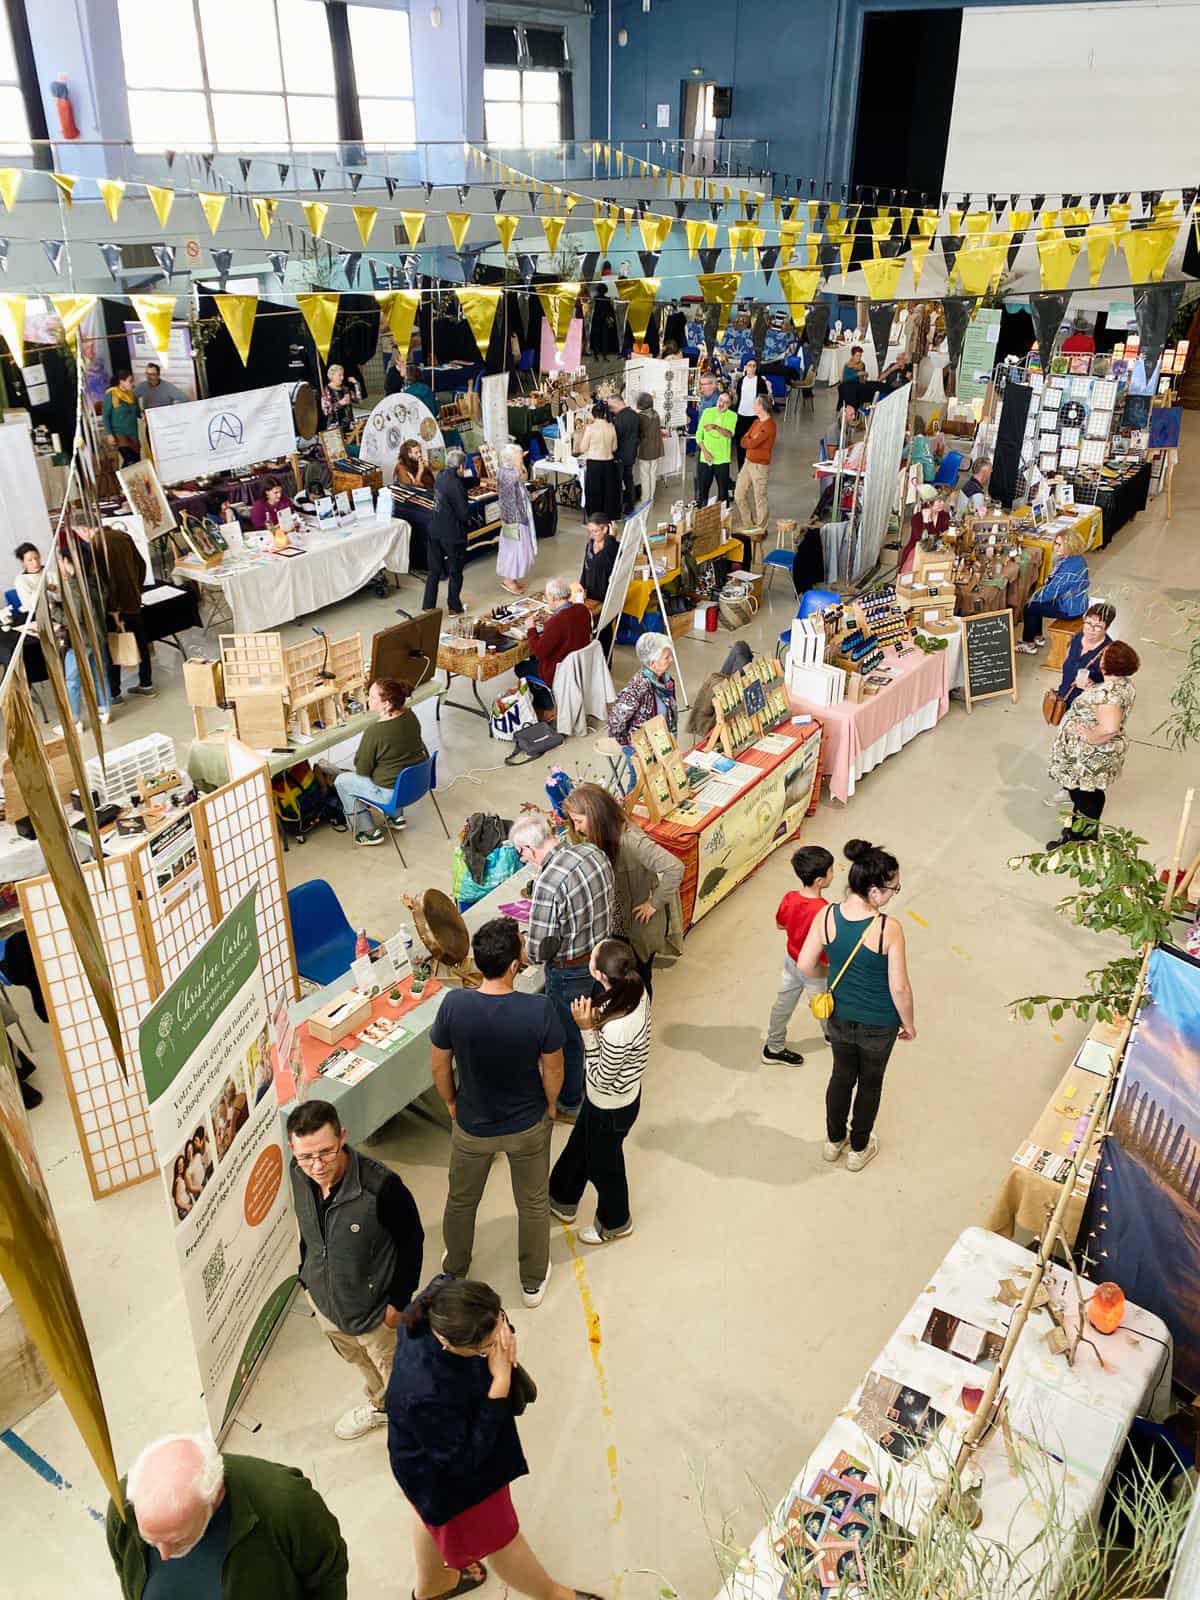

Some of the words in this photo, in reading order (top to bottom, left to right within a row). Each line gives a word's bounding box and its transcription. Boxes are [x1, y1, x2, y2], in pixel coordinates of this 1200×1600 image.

[177, 963, 218, 1021] Christine
[173, 1081, 193, 1110] Votre
[223, 1029, 232, 1040] au
[232, 993, 256, 1028] naturel
[182, 1082, 207, 1119] chaque
[224, 1044, 233, 1059] de
[233, 1021, 250, 1047] votre
[186, 1219, 210, 1257] Prendre
